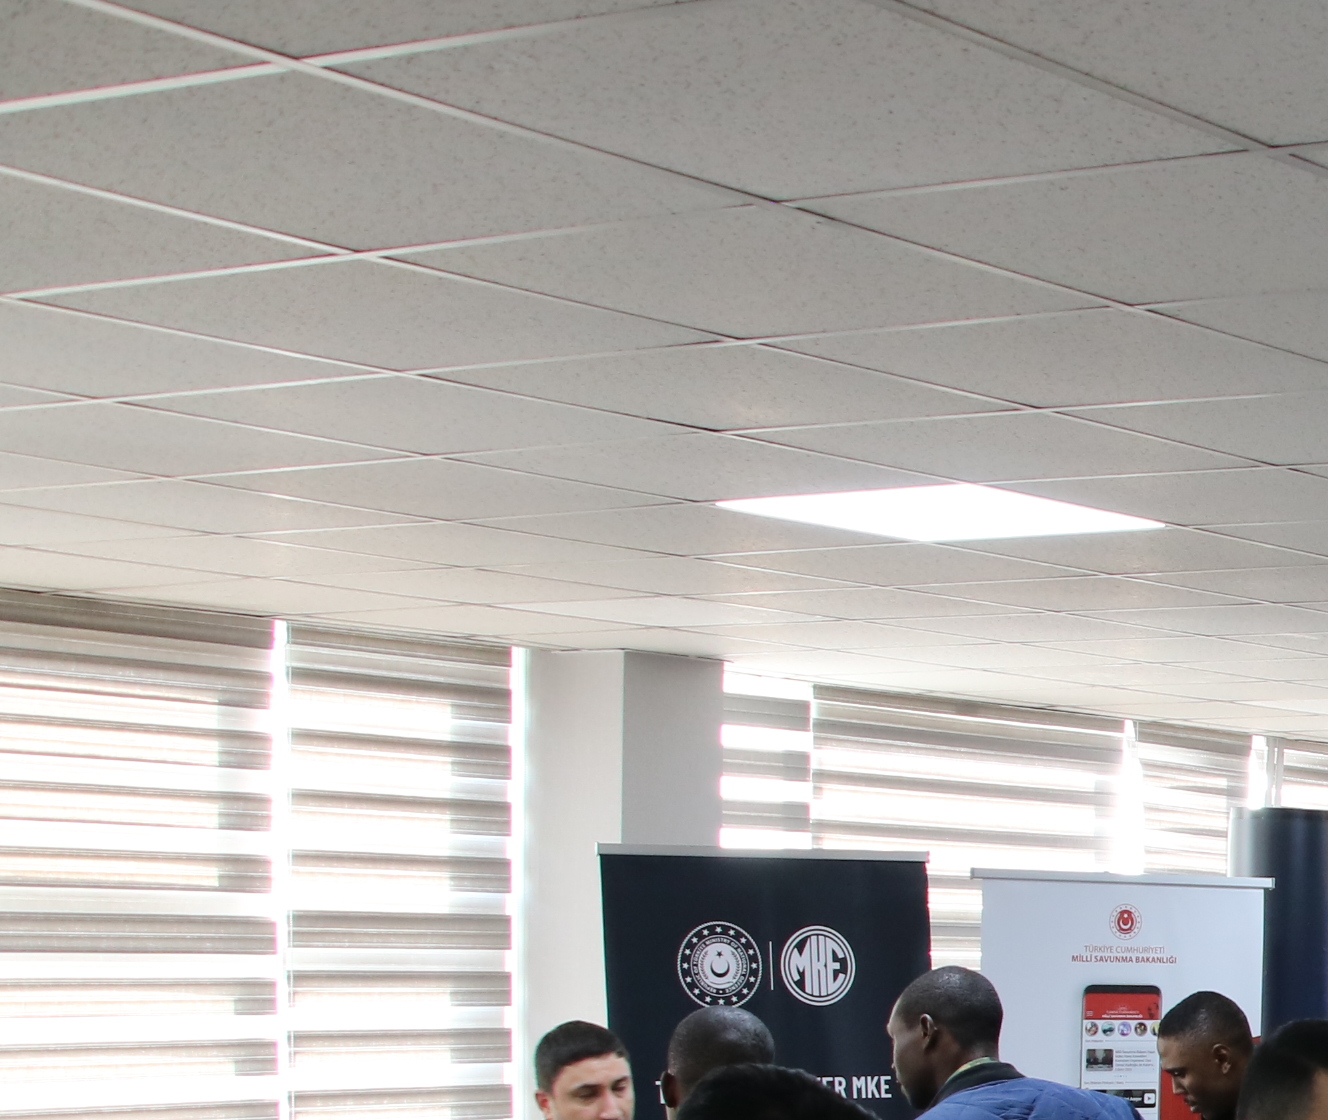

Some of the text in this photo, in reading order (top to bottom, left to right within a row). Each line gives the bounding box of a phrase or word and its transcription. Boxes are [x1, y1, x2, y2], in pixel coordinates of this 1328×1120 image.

[1084, 944, 1165, 954] TÜRKİYE CUMHURİYETİ
[788, 934, 847, 996] MKE
[1072, 953, 1177, 964] MİLLİ SAVUNMA BAKANLIĞI
[852, 1076, 893, 1099] MKE
